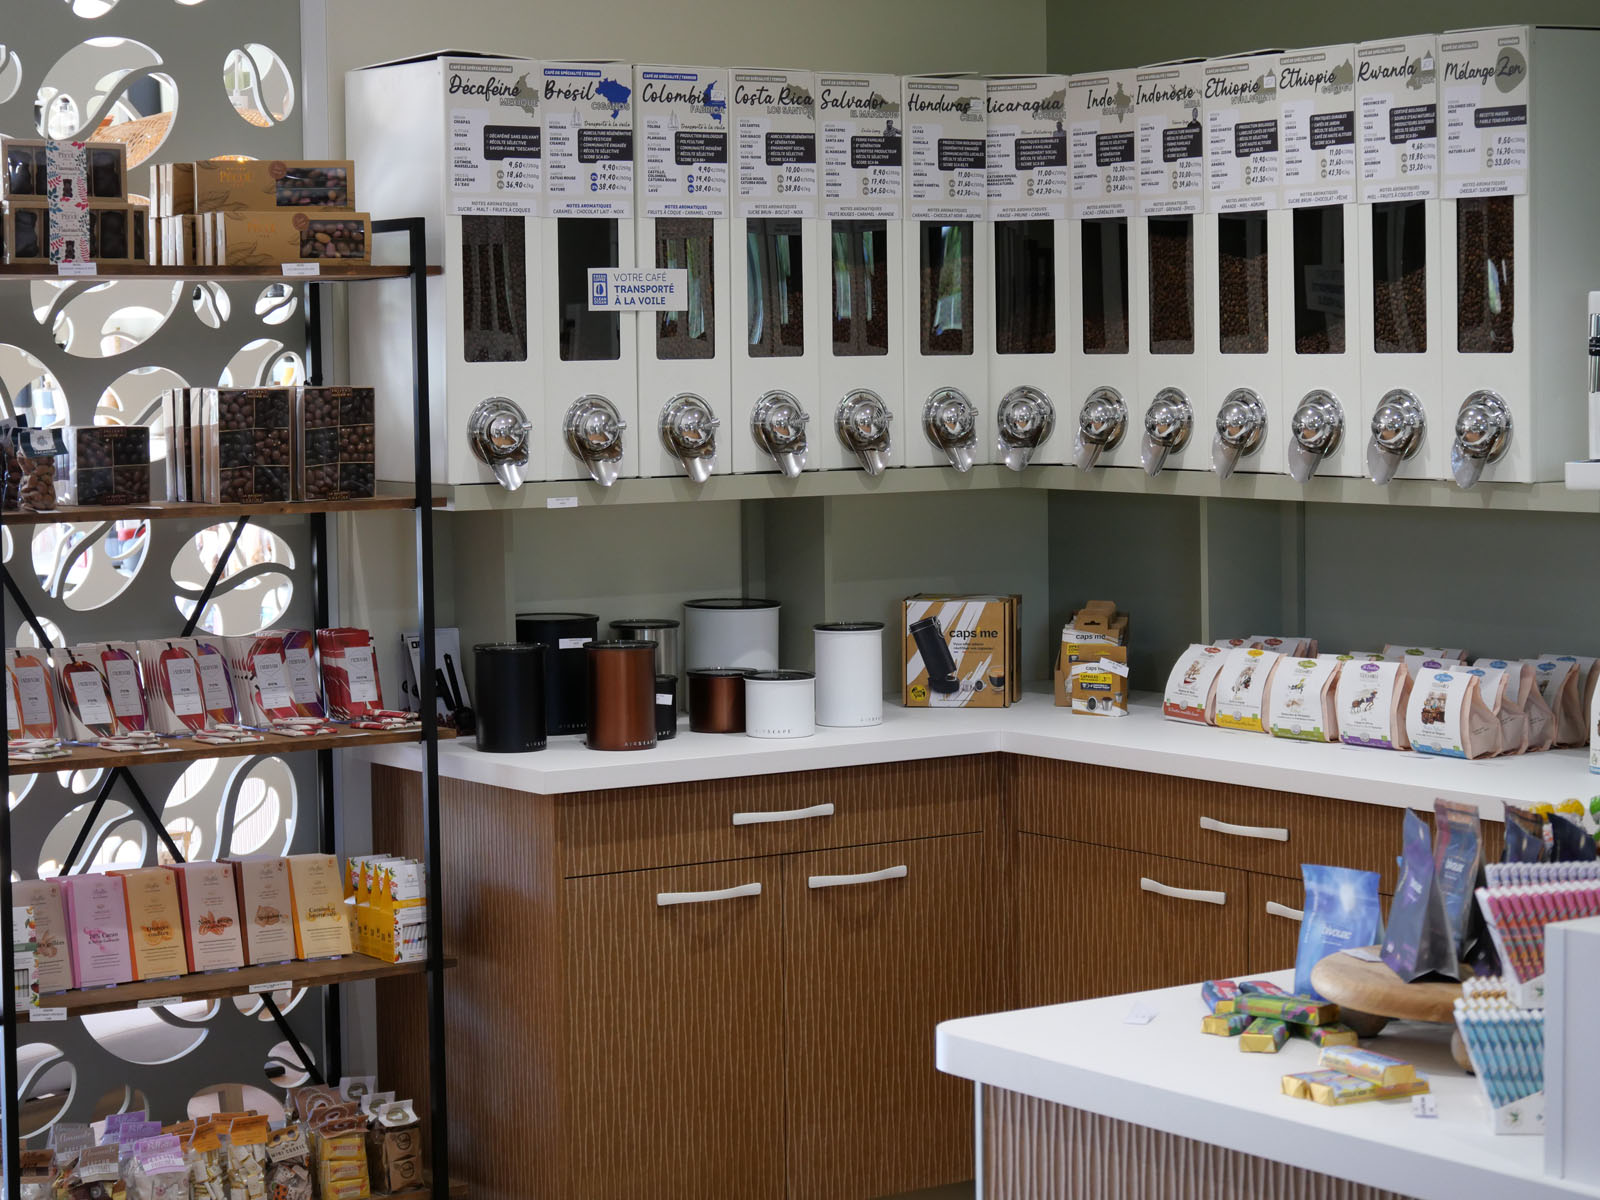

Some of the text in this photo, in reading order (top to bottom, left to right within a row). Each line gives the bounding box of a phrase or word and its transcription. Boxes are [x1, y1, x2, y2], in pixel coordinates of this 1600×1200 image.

[1358, 56, 1418, 82] Rwanda
[1444, 56, 1524, 85] Mélange Zen
[449, 74, 521, 102] Décaféiné
[544, 80, 595, 101] Brésil
[1205, 78, 1260, 101] Ethiopie
[1280, 68, 1336, 93] Ethiopie
[735, 85, 814, 105] Costa Rica
[821, 89, 888, 110] Salvador
[908, 93, 971, 113] Honduras
[1087, 88, 1114, 109] Inde
[614, 273, 643, 281] VOTRE
[645, 272, 666, 281] CAFÉ
[614, 283, 674, 293] TRANSPORTÉ
[614, 295, 621, 305] À
[949, 630, 976, 640] caps
